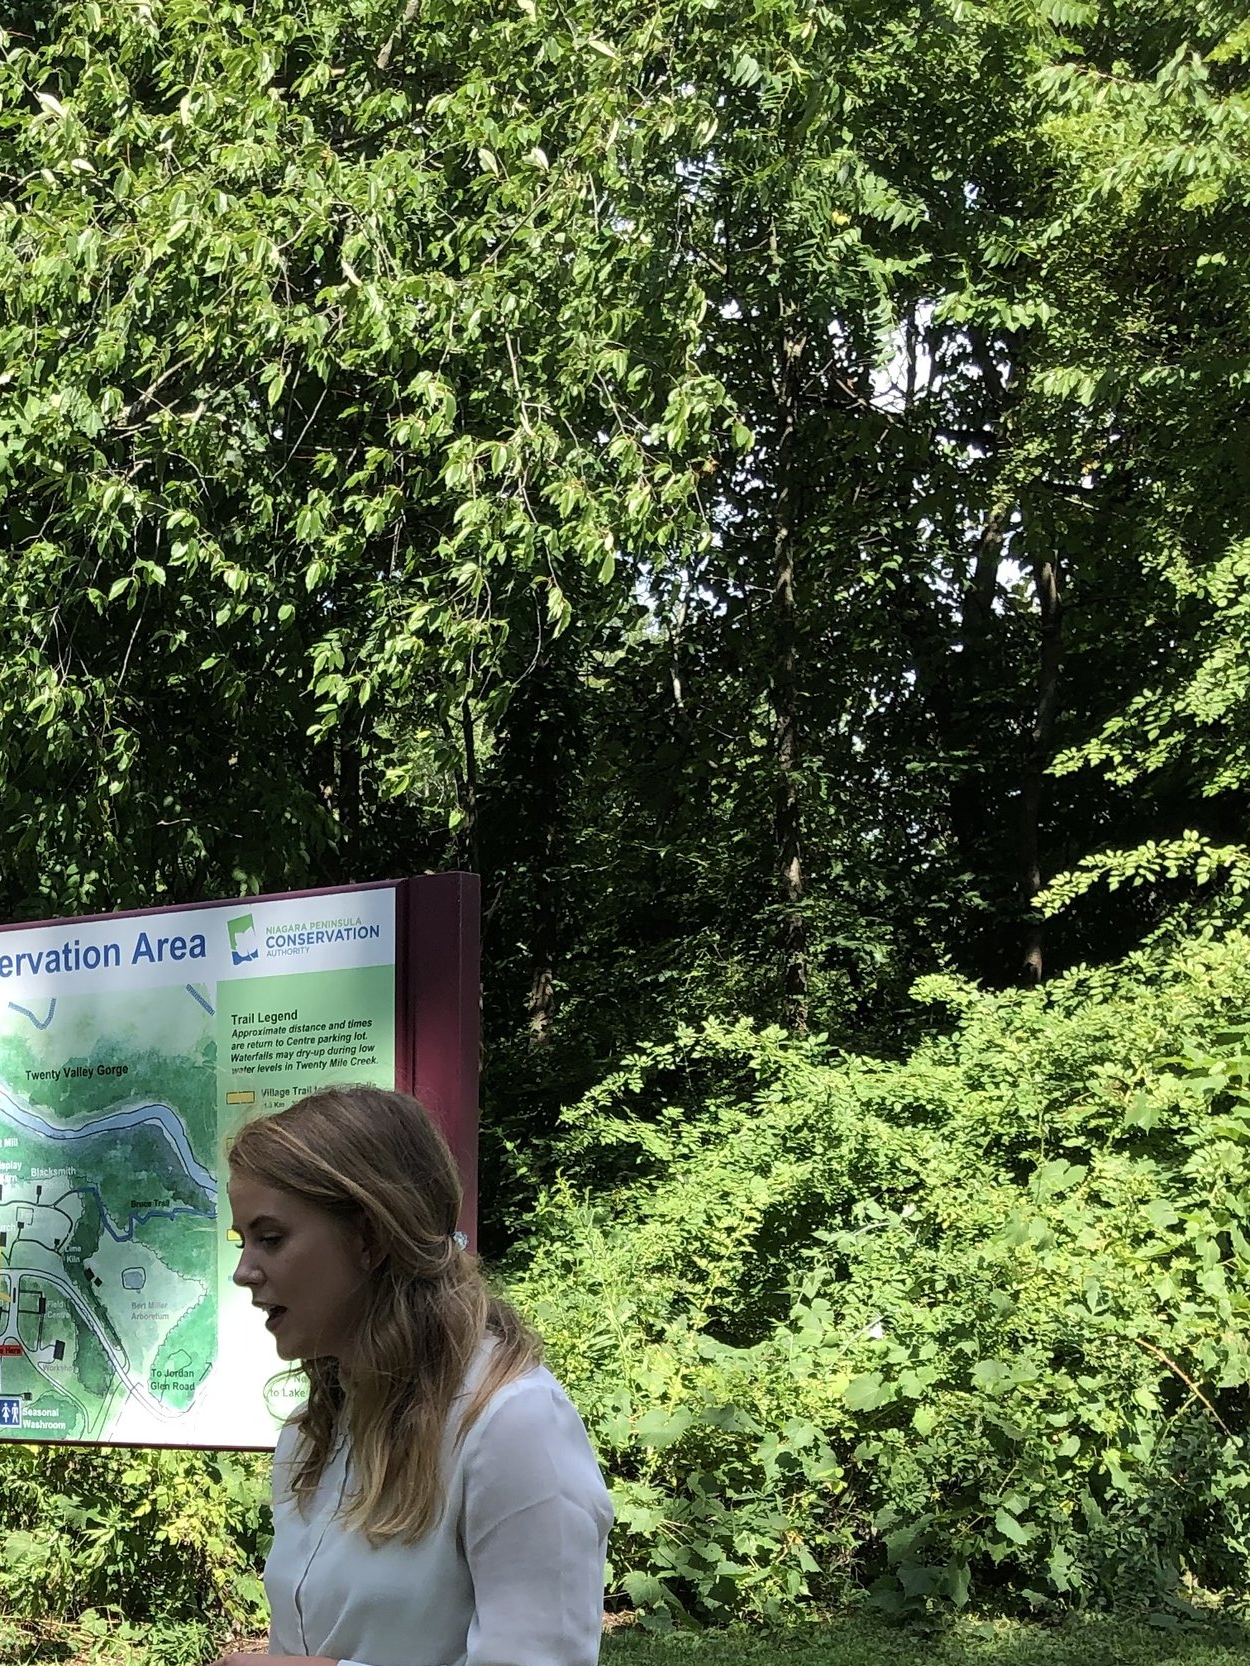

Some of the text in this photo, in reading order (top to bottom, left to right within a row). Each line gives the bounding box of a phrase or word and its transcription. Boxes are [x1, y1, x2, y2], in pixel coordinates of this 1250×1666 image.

[266, 917, 362, 935] NIAGARA PENINSULA
[266, 925, 380, 948] CONSERVATION
[131, 932, 206, 964] Area
[266, 946, 310, 957] AUTHORITY
[231, 1009, 298, 1025] Trail Legend
[232, 1019, 373, 1040] Approximate distance and times
[231, 1043, 245, 1051] are
[247, 1040, 273, 1049] return
[275, 1039, 284, 1047] to
[287, 1036, 316, 1046] Centre
[317, 1033, 352, 1045] parking
[231, 1044, 375, 1062] Waterfalls may dry-up during low
[232, 1066, 255, 1074] water
[257, 1063, 282, 1073] levels
[285, 1062, 293, 1070] in
[296, 1060, 327, 1070] Twenty
[329, 1058, 348, 1067] Mile
[25, 1064, 129, 1081] Twenty Valley Gorge
[261, 1087, 290, 1098] Village
[293, 1086, 312, 1095] Trail
[4, 1137, 18, 1147] Mill
[30, 1166, 77, 1177] Blacksmith
[131, 1199, 170, 1208] Bruce Trail
[47, 1300, 64, 1308] Field
[131, 1301, 168, 1310] Bert Miller
[47, 1310, 70, 1318] Centre
[131, 1311, 170, 1321] Arboretum
[6, 1346, 21, 1354] Here
[151, 1368, 195, 1378] To Jordan
[150, 1381, 195, 1391] Glen Road
[282, 1388, 306, 1398] Lake
[22, 1407, 59, 1417] Seasonal
[23, 1419, 66, 1430] Washroom
